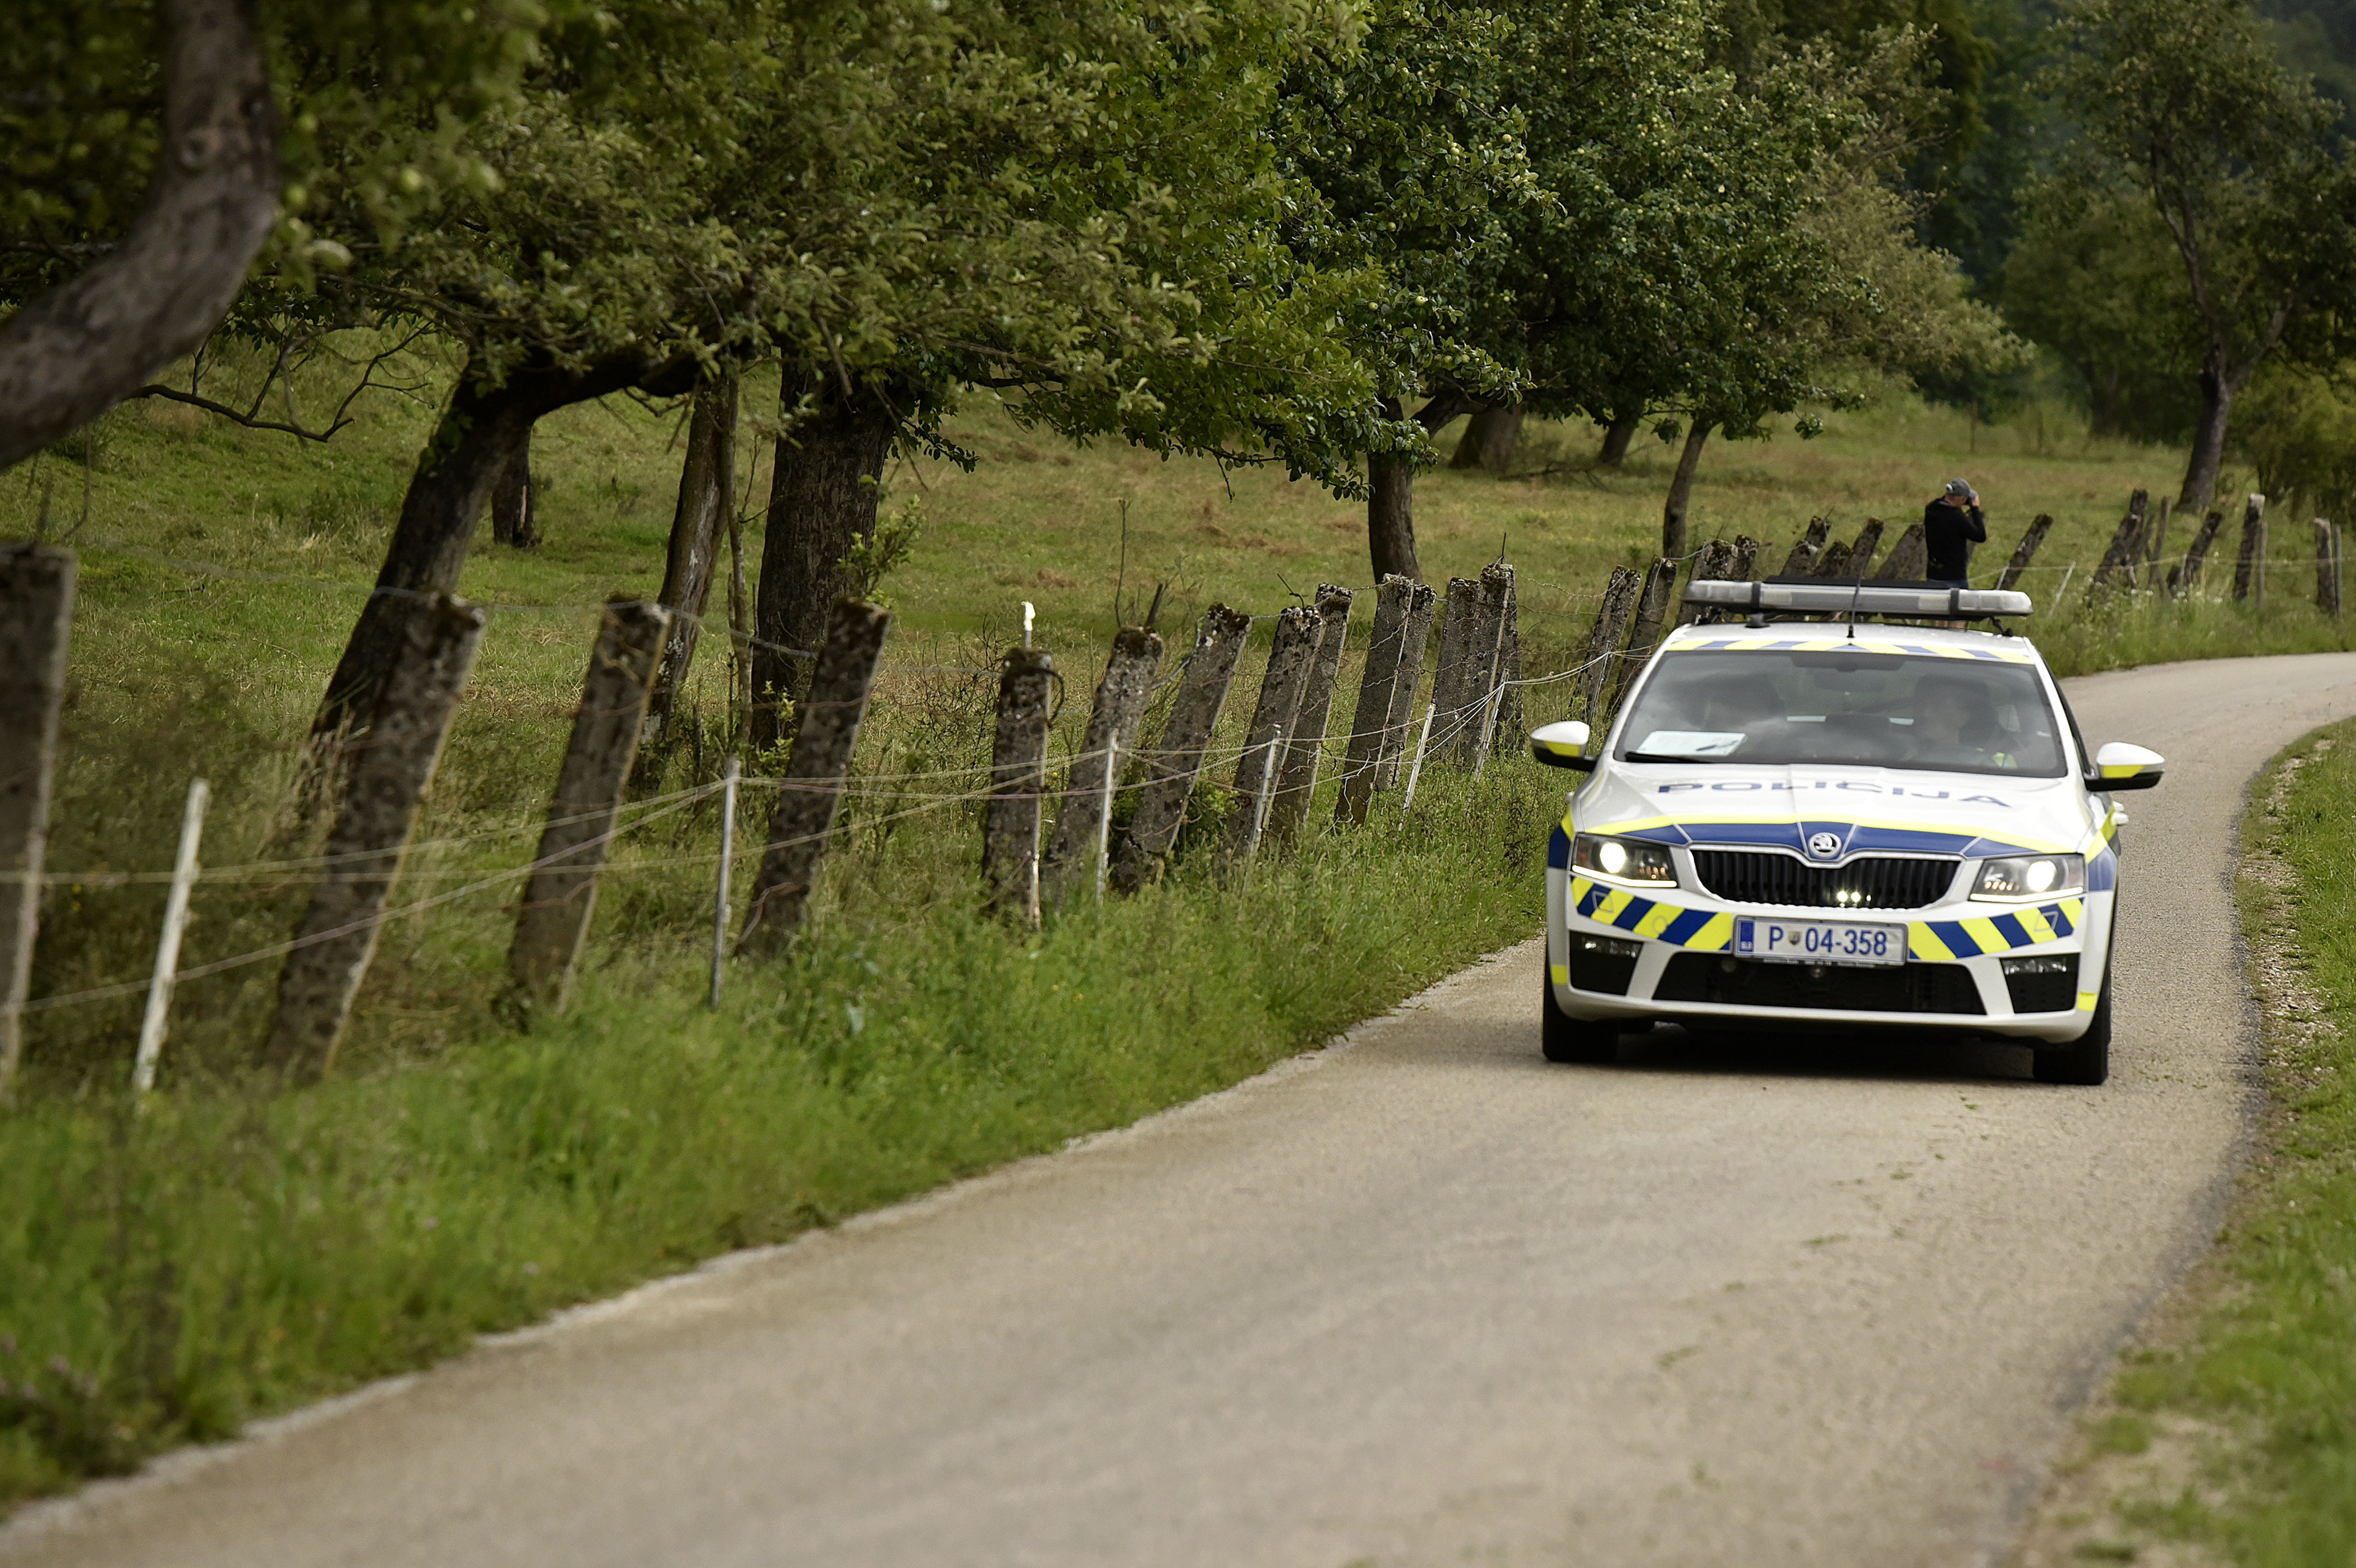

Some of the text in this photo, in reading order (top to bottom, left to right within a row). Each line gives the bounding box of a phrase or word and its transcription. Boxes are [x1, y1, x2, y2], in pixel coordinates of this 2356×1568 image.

[1658, 780, 2012, 807] POLICIJA
[1769, 926, 1887, 955] P 04-358
